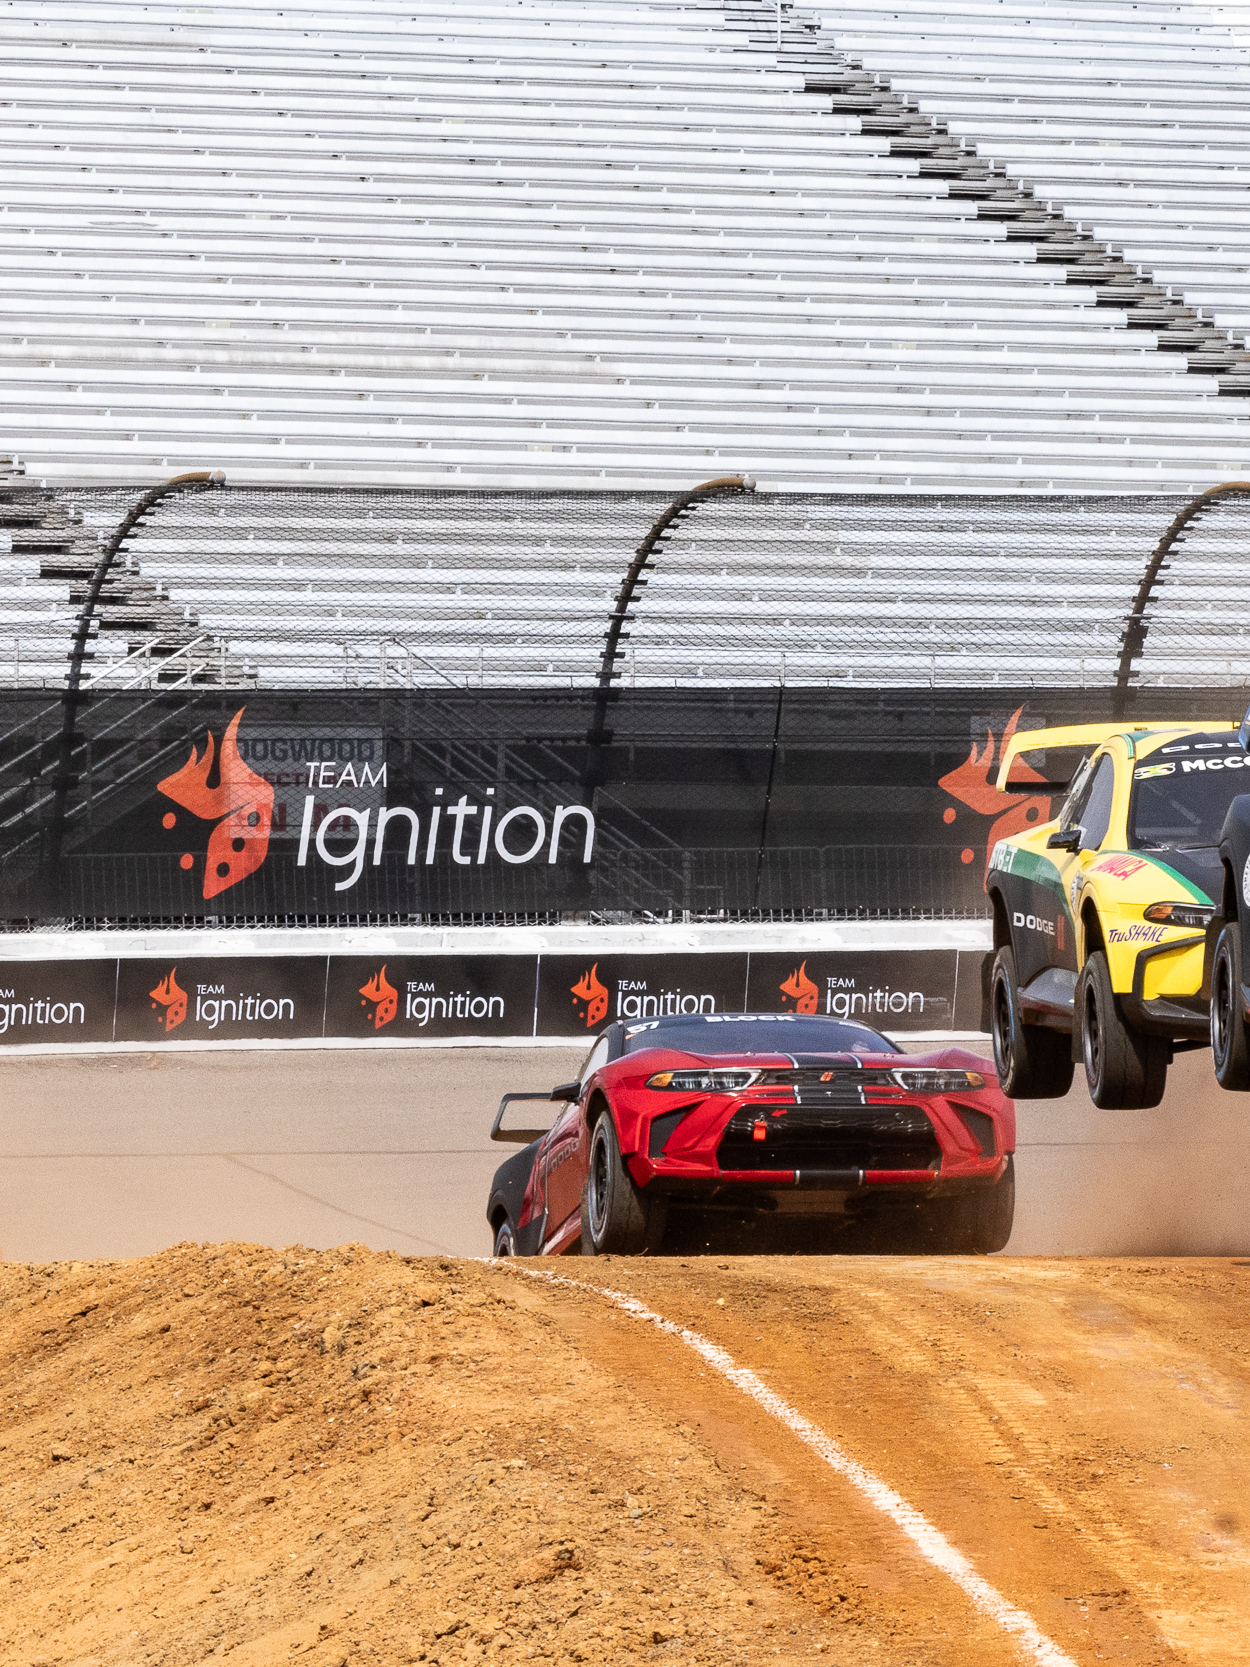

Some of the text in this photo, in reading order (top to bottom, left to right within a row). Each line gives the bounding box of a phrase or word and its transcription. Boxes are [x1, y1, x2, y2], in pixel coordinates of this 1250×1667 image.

[305, 761, 388, 788] TEAM
[297, 787, 596, 892] Ignition
[1013, 912, 1056, 936] DODGE
[197, 984, 225, 995] TEAM
[407, 981, 435, 992] TEAM
[618, 980, 647, 991] TEAM
[826, 977, 855, 988] TEAM
[195, 992, 295, 1029] Ignition
[405, 990, 505, 1027] Ignition
[826, 985, 924, 1020] Ignition
[627, 1020, 660, 1034] 57
[704, 1014, 797, 1023] BLOCK
